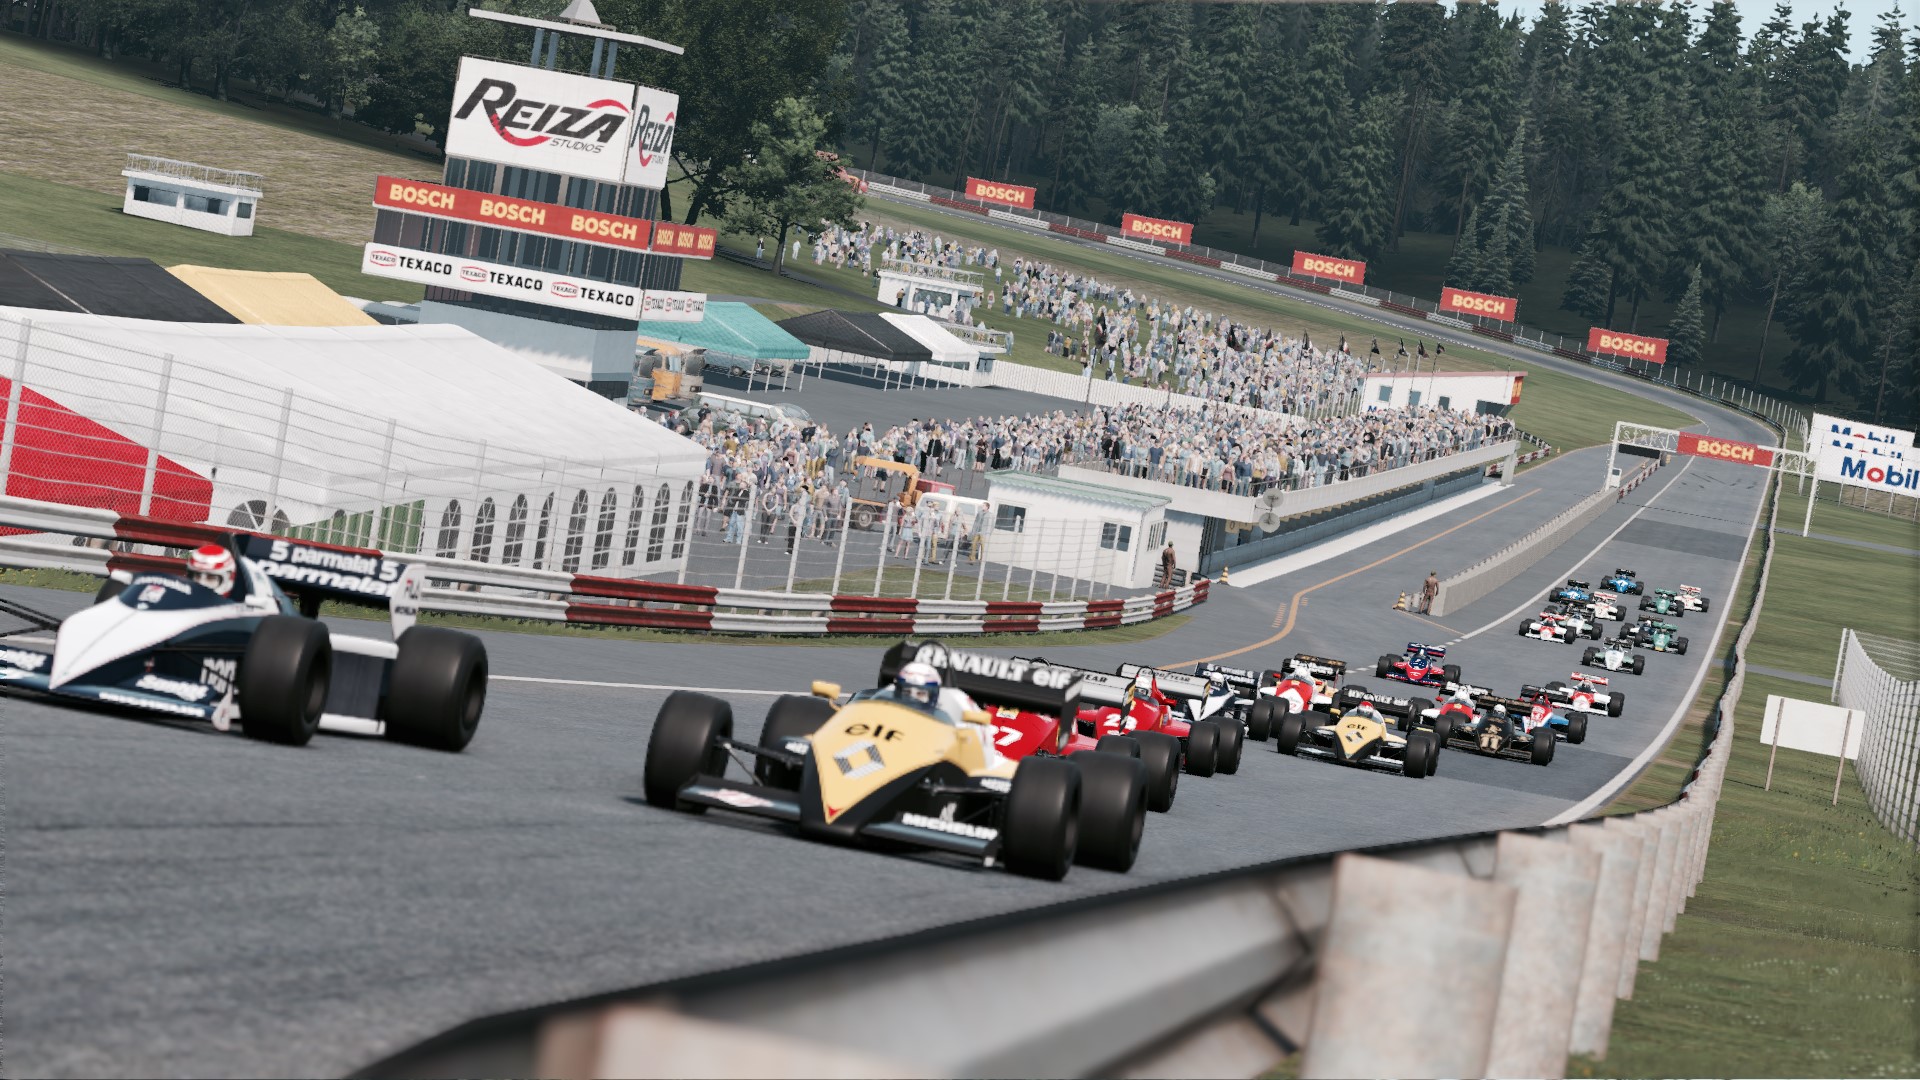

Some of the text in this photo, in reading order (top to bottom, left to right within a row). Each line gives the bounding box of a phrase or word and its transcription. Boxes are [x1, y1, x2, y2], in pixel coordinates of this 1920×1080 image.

[454, 77, 626, 146] REIZA
[550, 138, 604, 154] STUDIOS
[976, 183, 1025, 204] BOSCH
[389, 184, 638, 241] BOSCH BOSCH BOSCH
[1131, 220, 1182, 240] BOSCH
[1304, 258, 1354, 278] BOSCH
[372, 253, 634, 306] TEXACO TEXACO TEXACO TEXACO TEXACO TEXACO
[1452, 293, 1505, 315] BOSCH
[1600, 334, 1656, 356] BOSCH
[1697, 440, 1755, 462] BOSCH
[1841, 456, 1920, 490] Mobil
[269, 540, 291, 561] 5
[379, 560, 398, 582] 5
[914, 645, 1072, 689] RENAULT elf
[845, 723, 905, 742] elf
